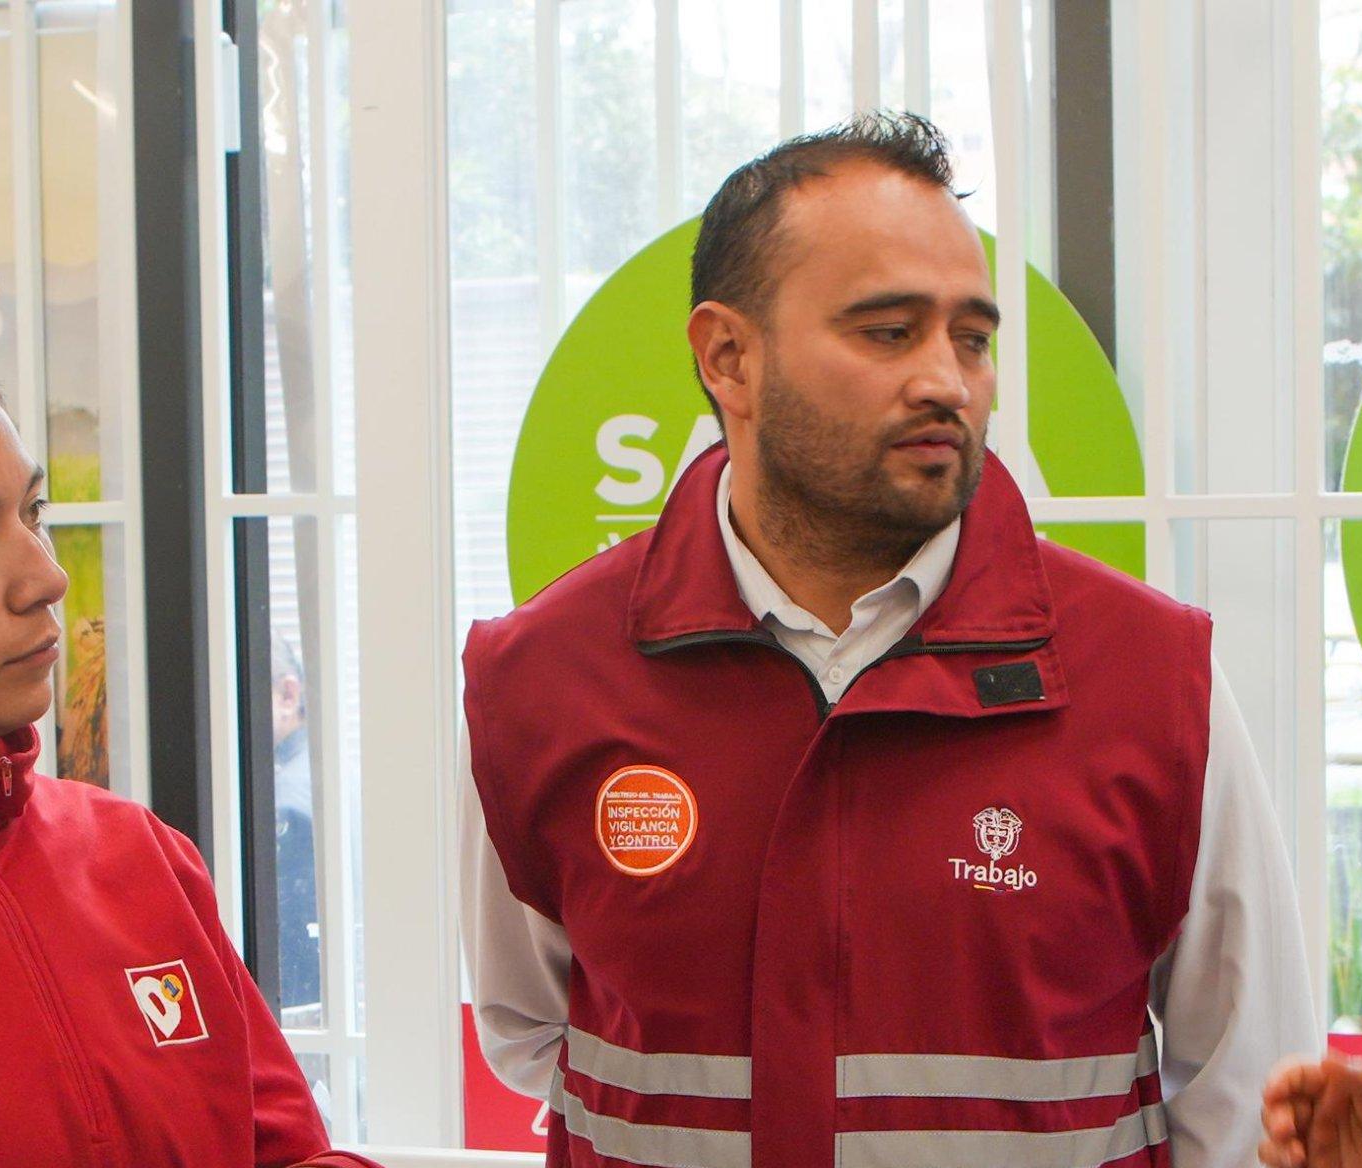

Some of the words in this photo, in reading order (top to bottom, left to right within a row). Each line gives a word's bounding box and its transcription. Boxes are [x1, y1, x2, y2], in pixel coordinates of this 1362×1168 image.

[608, 803, 681, 819] INSPECCIÓN
[609, 820, 679, 833] VIGILANCIA
[948, 858, 1037, 890] Trabajo
